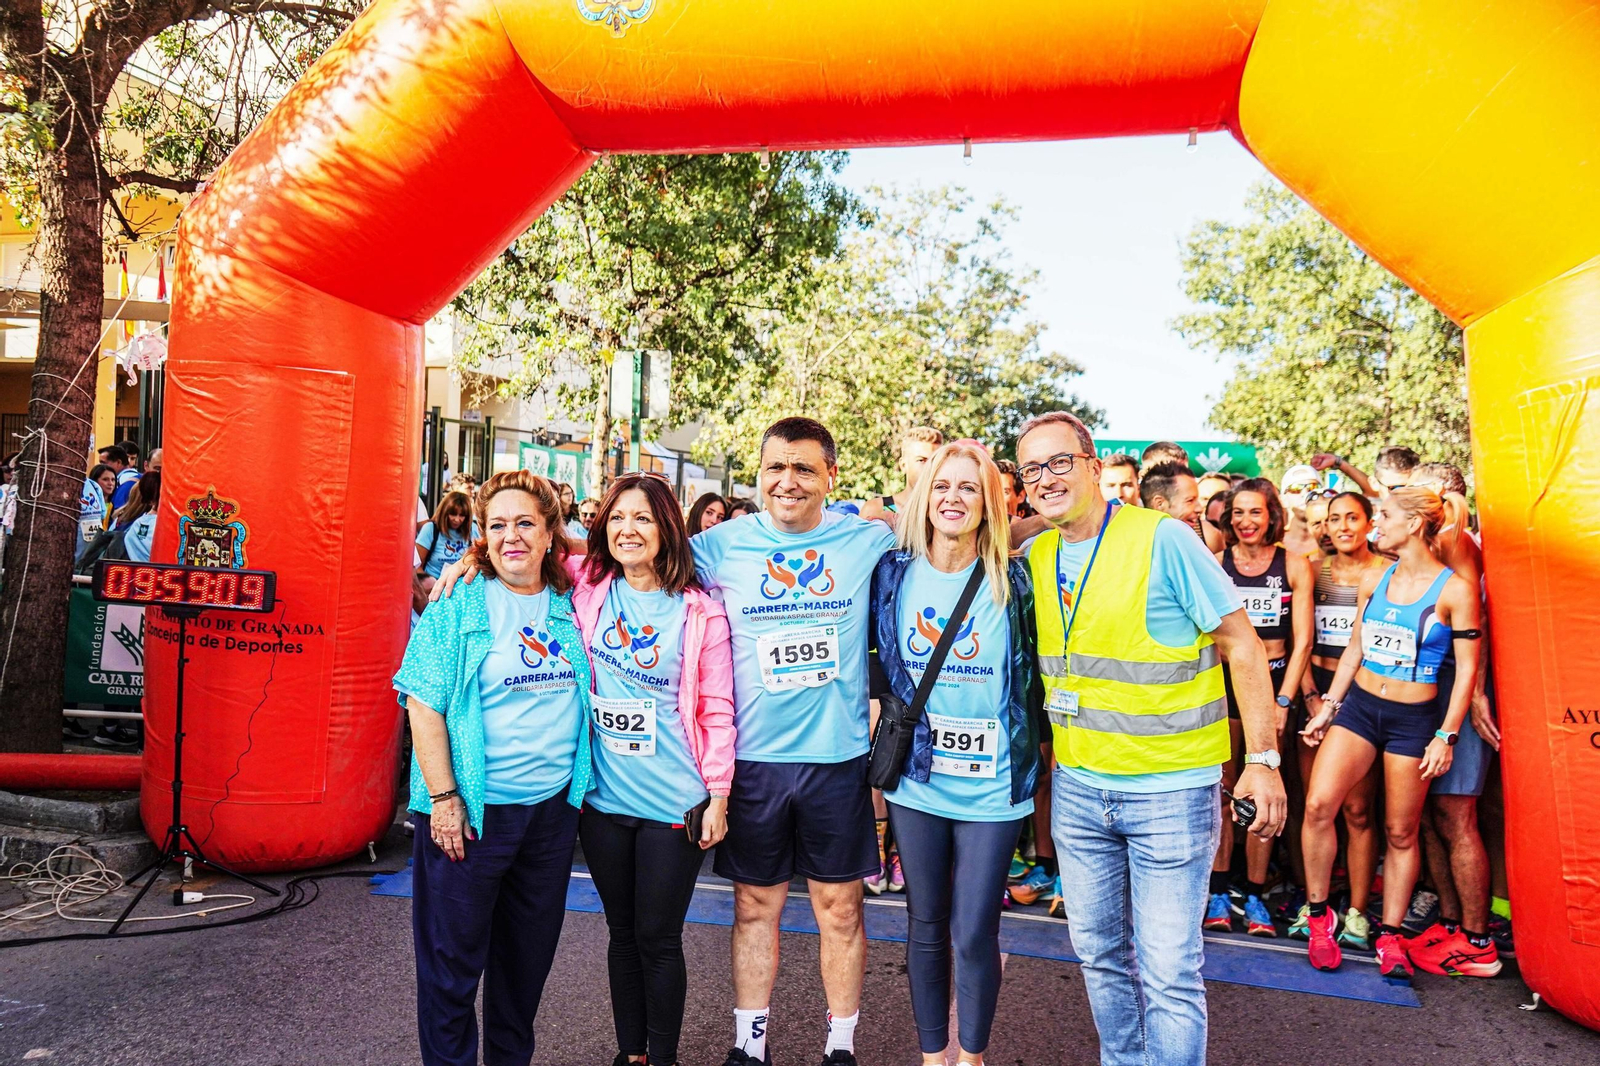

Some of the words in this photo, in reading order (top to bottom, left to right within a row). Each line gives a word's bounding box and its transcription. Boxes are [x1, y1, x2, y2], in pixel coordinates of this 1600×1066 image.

[742, 598, 853, 615] CARRERA-MARCHA
[1242, 598, 1272, 611] 185
[750, 615, 786, 623] SOLIDARIA
[787, 612, 814, 620] ASPACE
[816, 609, 848, 618] GRANADA
[215, 618, 236, 631] DE
[241, 618, 325, 636] GRANADA
[88, 605, 106, 670] fundación
[199, 634, 220, 648] de
[225, 637, 304, 655] Deportes
[1374, 634, 1402, 651] 271
[769, 641, 830, 665] 1595
[88, 672, 127, 686] CAJA
[511, 683, 544, 693] SOLIDARIA
[544, 681, 566, 690] ASPACE
[592, 707, 646, 732] 1592
[931, 728, 985, 752] 1591
